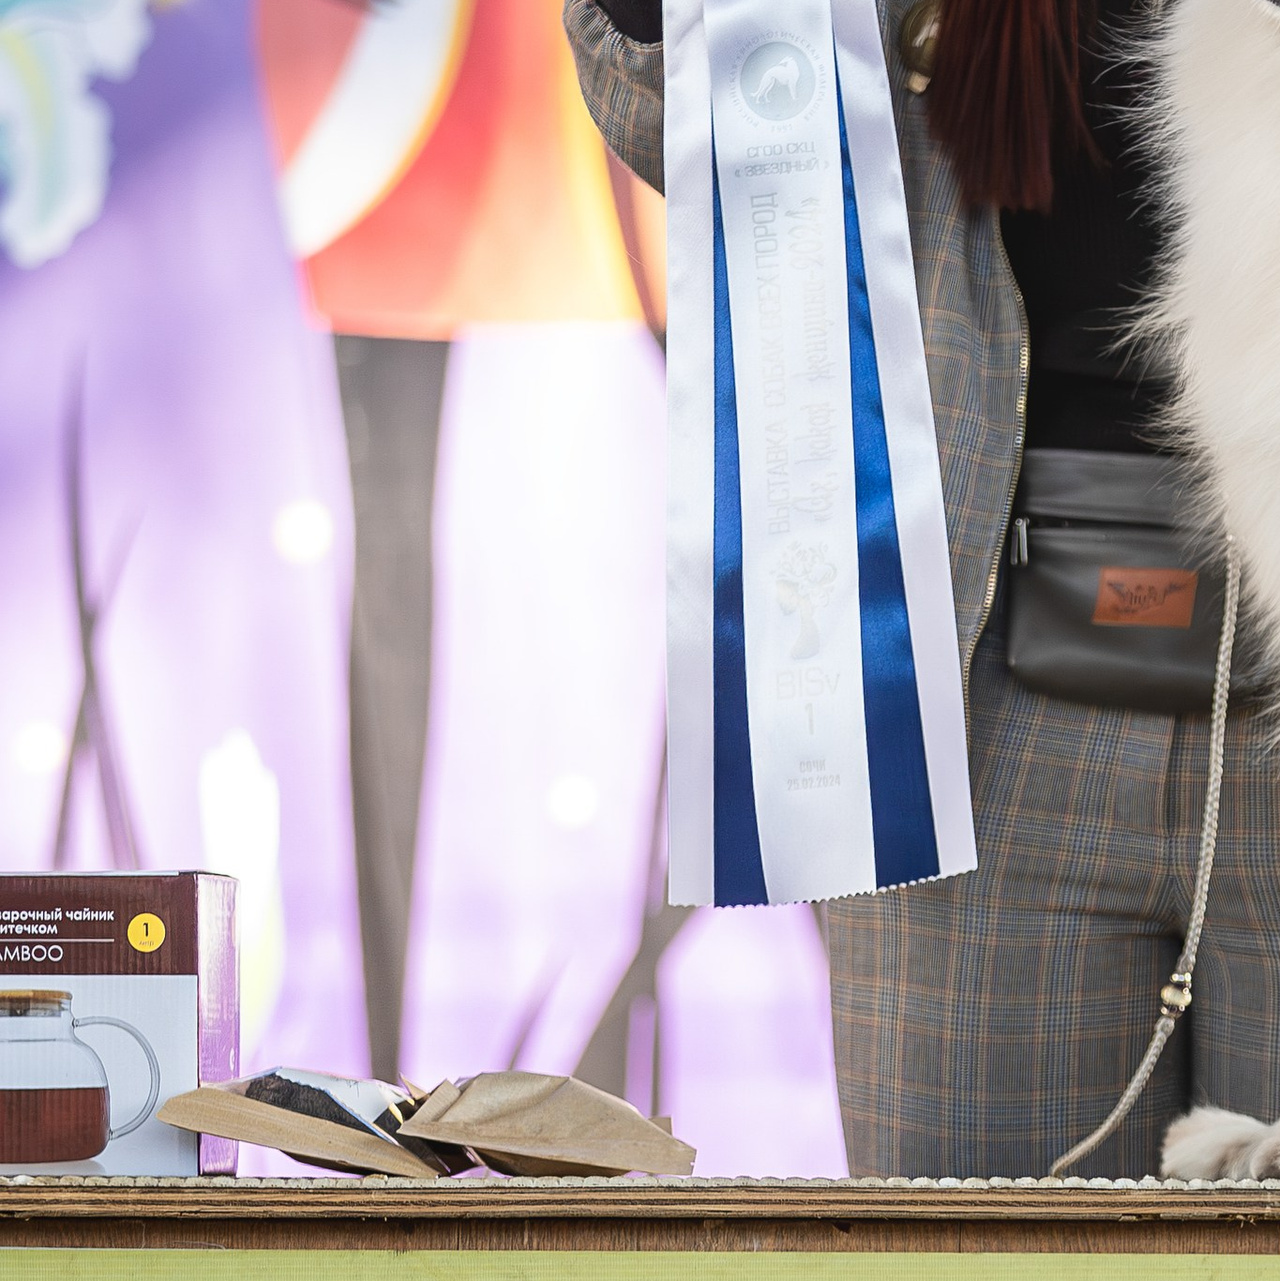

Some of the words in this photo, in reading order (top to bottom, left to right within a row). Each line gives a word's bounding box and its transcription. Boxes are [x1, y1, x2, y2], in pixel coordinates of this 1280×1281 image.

[746, 143, 783, 158] СГОО
[786, 141, 816, 155] СКЦ
[750, 192, 780, 270] ПОРОД
[756, 273, 782, 329] ВСЕХ
[760, 334, 787, 407] СОБАК
[763, 419, 790, 536] ВЫСТАВКА
[776, 666, 841, 700] BISv
[804, 702, 815, 736] 1
[799, 759, 827, 773] СОЧИ
[0, 907, 63, 924] арочный
[65, 907, 115, 922] чайник
[142, 922, 149, 938] 1
[0, 944, 64, 962] MBOO
